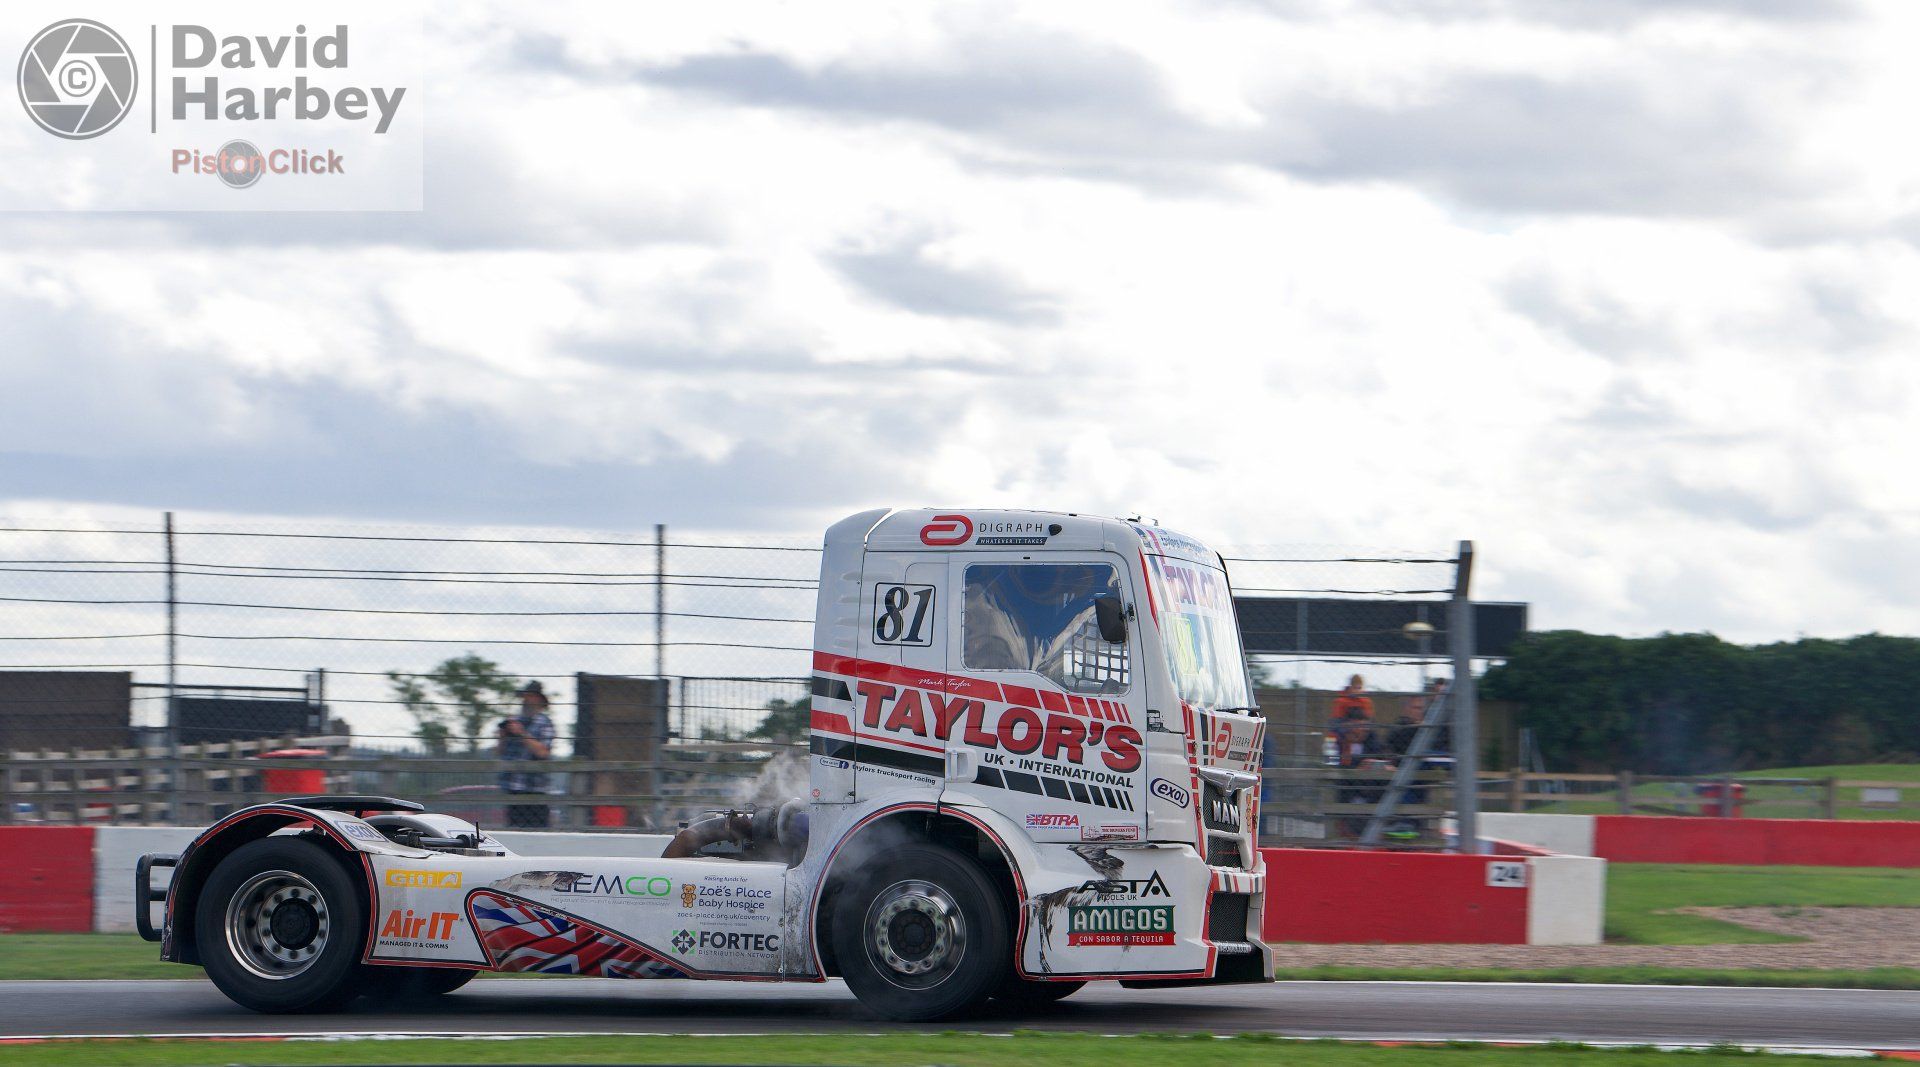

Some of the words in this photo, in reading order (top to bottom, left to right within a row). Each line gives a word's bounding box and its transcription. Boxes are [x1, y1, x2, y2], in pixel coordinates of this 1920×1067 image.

[979, 522, 1043, 533] DIGRAPH
[876, 586, 934, 642] 81
[918, 678, 944, 686] Mark
[946, 678, 971, 690] Taylor
[857, 680, 1143, 774] TAYLOR'S
[852, 764, 876, 774] taylors
[876, 768, 913, 781] trucksport
[914, 774, 936, 785] racing
[984, 752, 1005, 766] UK
[1018, 758, 1134, 789] INTERNATIONAL
[1212, 799, 1240, 827] MAN
[1039, 814, 1080, 826] BTRA
[390, 873, 433, 885] Giti
[699, 885, 732, 897] Zoë's
[736, 887, 772, 899] Place
[698, 899, 724, 910] Baby
[726, 900, 765, 911] Hospice
[677, 912, 771, 922] zoes-place.org.uk/coventry
[1073, 908, 1168, 931] AMIGOS
[379, 940, 412, 948] MANAGED
[425, 942, 449, 950] COMMS
[699, 931, 780, 952] FORTEC
[698, 950, 745, 958] DISTRIBUTION
